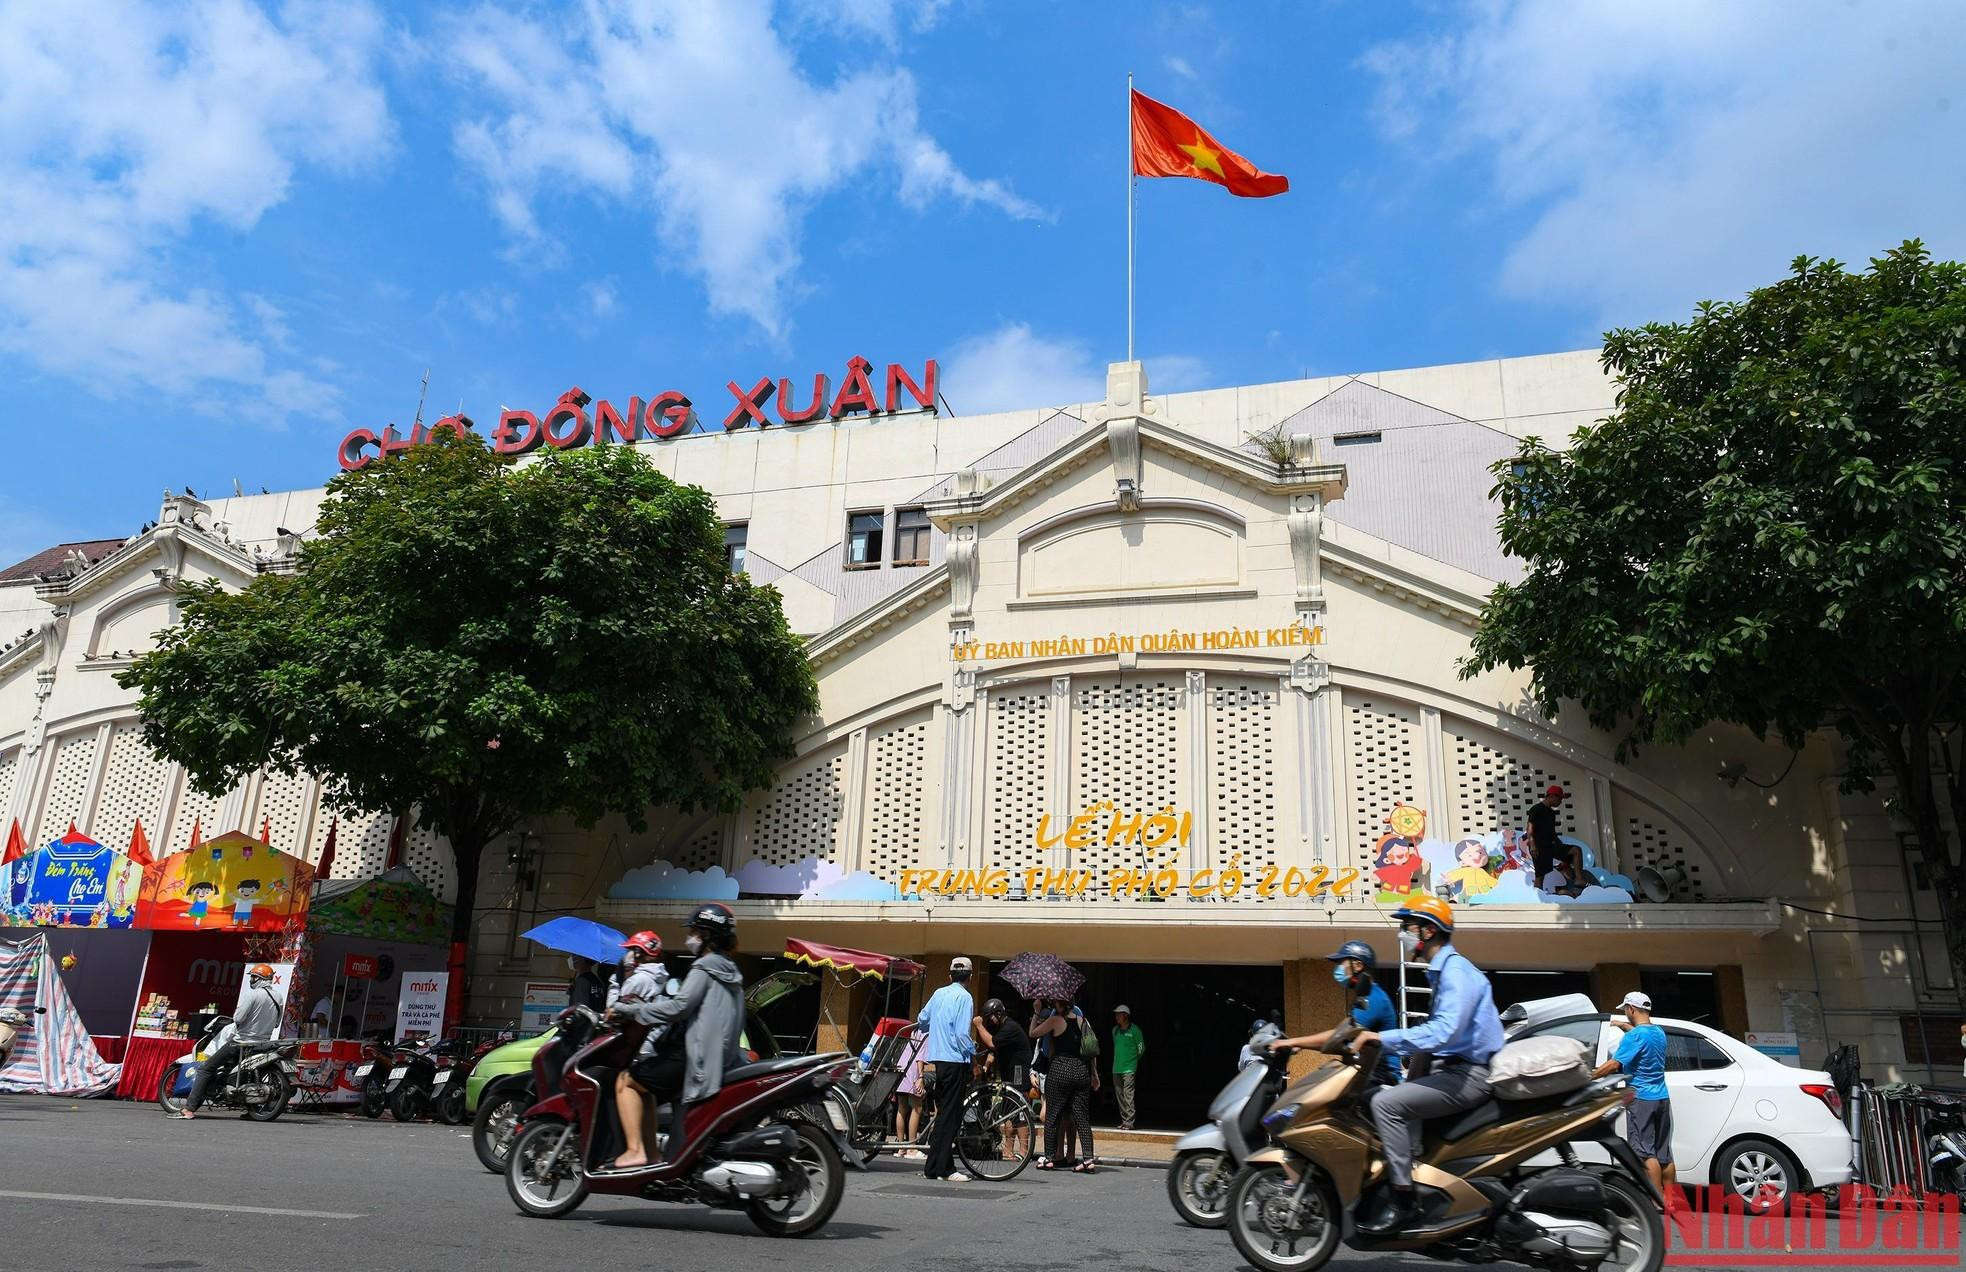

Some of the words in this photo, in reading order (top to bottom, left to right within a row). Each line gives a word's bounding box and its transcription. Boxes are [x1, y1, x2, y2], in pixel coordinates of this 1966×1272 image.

[491, 386, 697, 455] ĐỒNG
[723, 355, 940, 431] XUÂN
[985, 641, 1024, 660] BAN
[1030, 634, 1086, 657] NHÂN
[1093, 632, 1134, 655] DÂN
[1202, 626, 1259, 650] HOÀN
[1266, 618, 1322, 647] KIẾM
[1035, 800, 1114, 850] LỄ
[1105, 805, 1192, 856] HỘI
[45, 861, 66, 877] Đêm
[68, 861, 96, 881] Trăng
[68, 877, 86, 902] Cho
[86, 877, 105, 895] Em
[898, 864, 1010, 897] TRUNG
[1021, 867, 1092, 897] THU
[1107, 851, 1181, 898] PHỐ
[1188, 852, 1244, 898] CỔ
[1255, 865, 1360, 898] 2022
